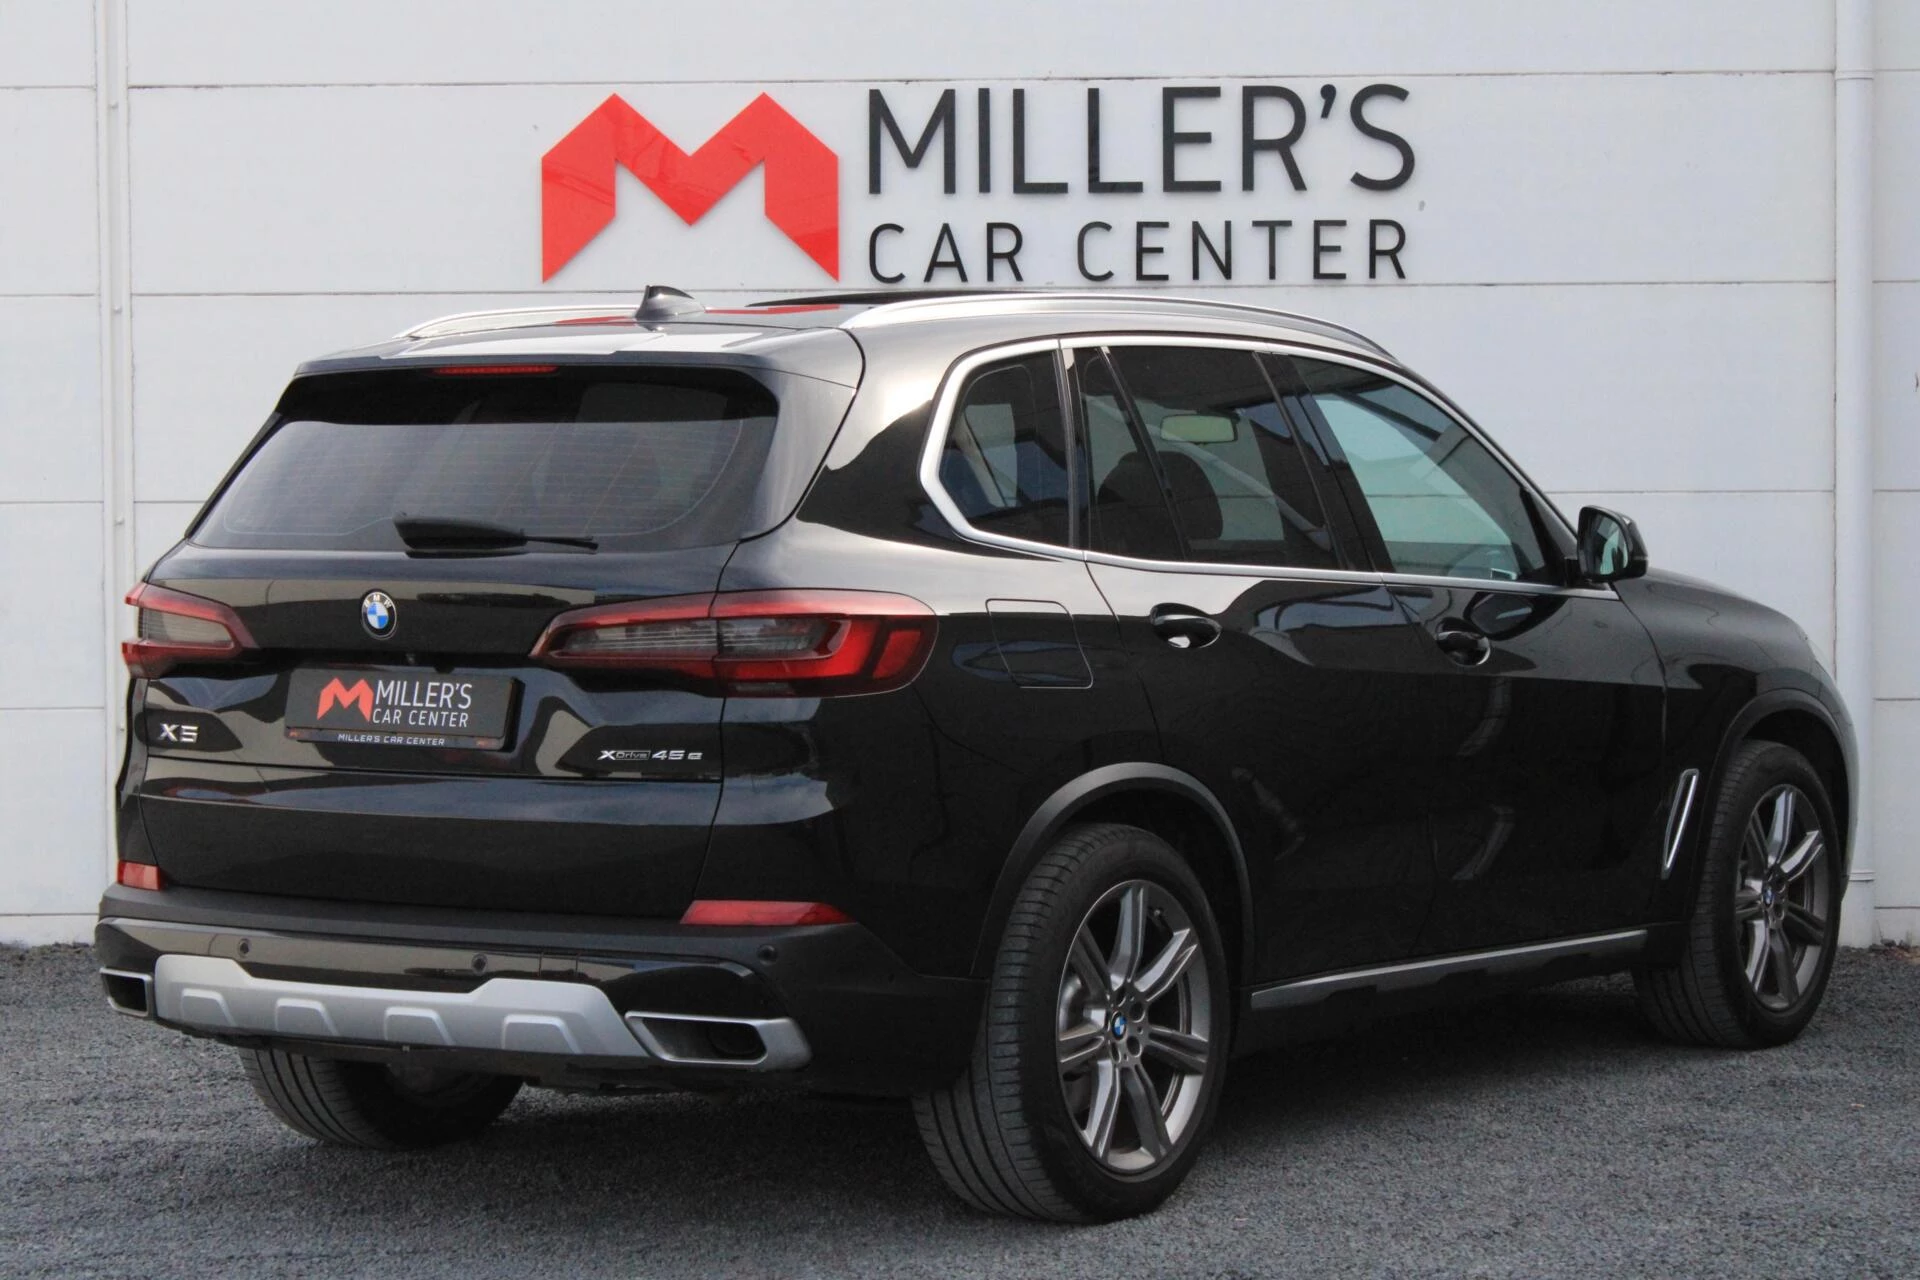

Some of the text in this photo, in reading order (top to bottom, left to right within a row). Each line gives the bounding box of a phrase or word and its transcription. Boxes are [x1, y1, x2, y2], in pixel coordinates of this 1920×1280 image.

[869, 84, 1415, 195] MILLER'S
[869, 219, 1408, 283] CAR CENTER
[375, 680, 473, 709] MILLER'S
[372, 708, 469, 728] CAR CENTER
[158, 723, 198, 743] X5
[383, 735, 404, 745] CAR
[406, 736, 445, 746] CENTER
